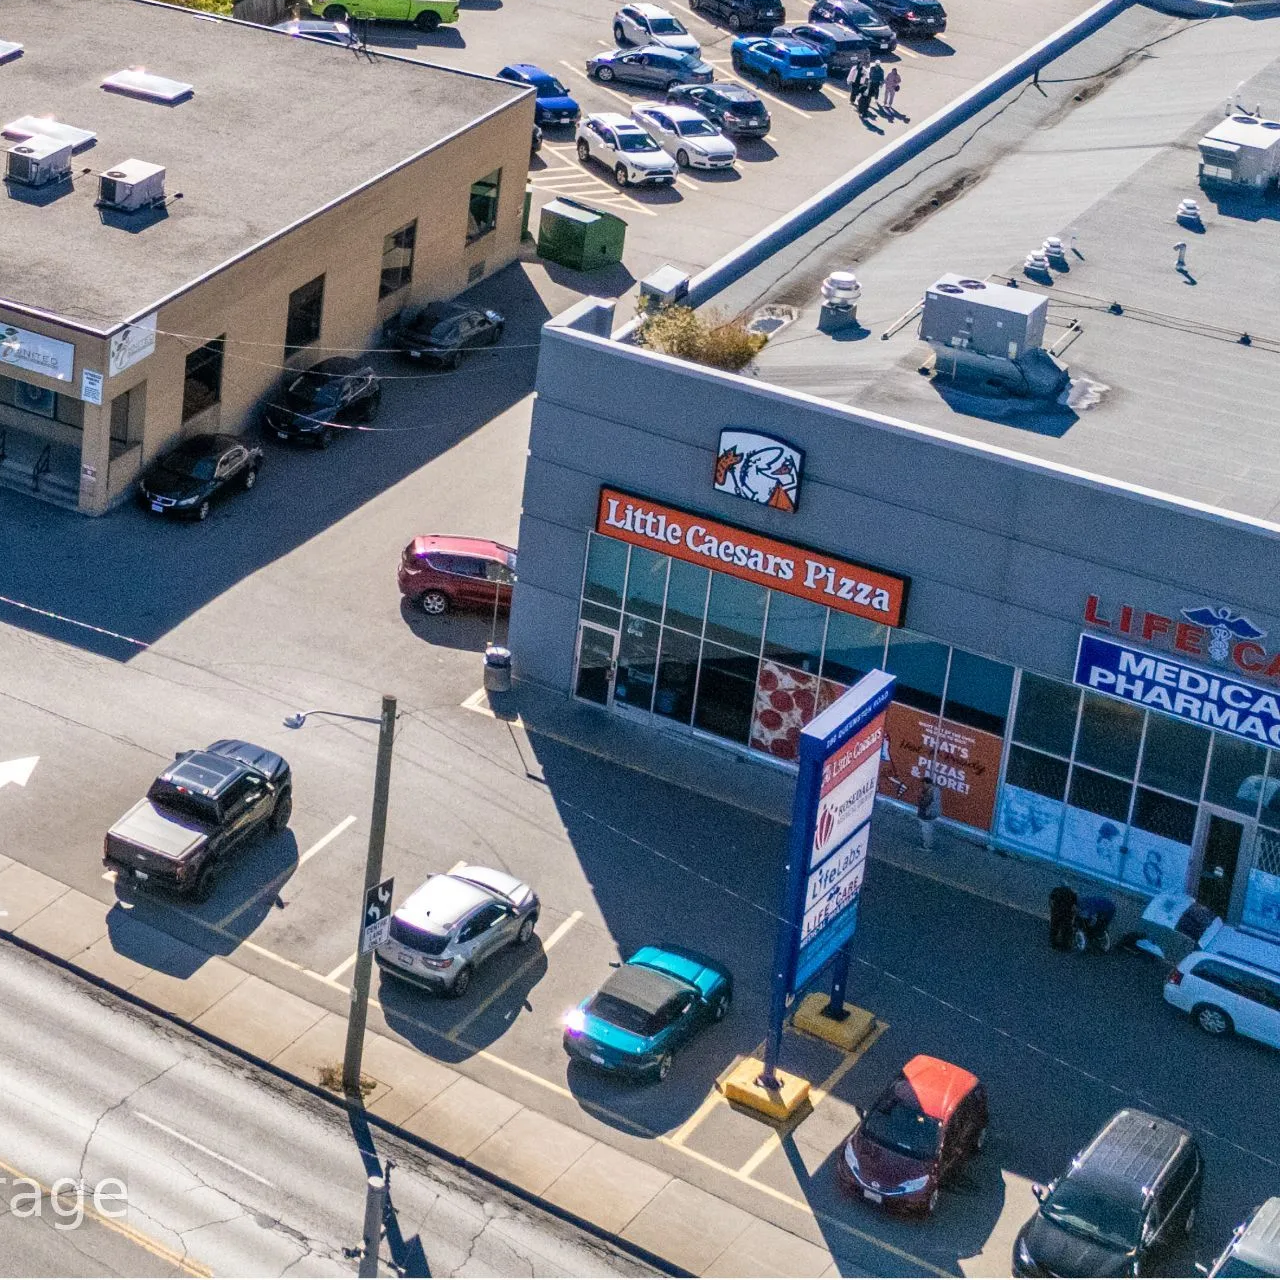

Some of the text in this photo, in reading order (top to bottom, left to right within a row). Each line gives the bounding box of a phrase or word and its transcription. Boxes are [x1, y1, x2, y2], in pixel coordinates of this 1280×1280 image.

[605, 498, 890, 612] Little Caesars Pizza
[1084, 593, 1205, 655] LIFE
[873, 691, 889, 709] ROAD
[832, 750, 853, 776] Little
[853, 727, 883, 760] Caesars
[921, 733, 969, 759] THAT'S
[910, 766, 971, 795] & MORE!
[918, 756, 966, 782] PIZZAS
[838, 776, 876, 816] ROSEDALE
[812, 844, 862, 900] LifeLabs
[806, 906, 830, 933] LIFE
[835, 876, 859, 909] CARE
